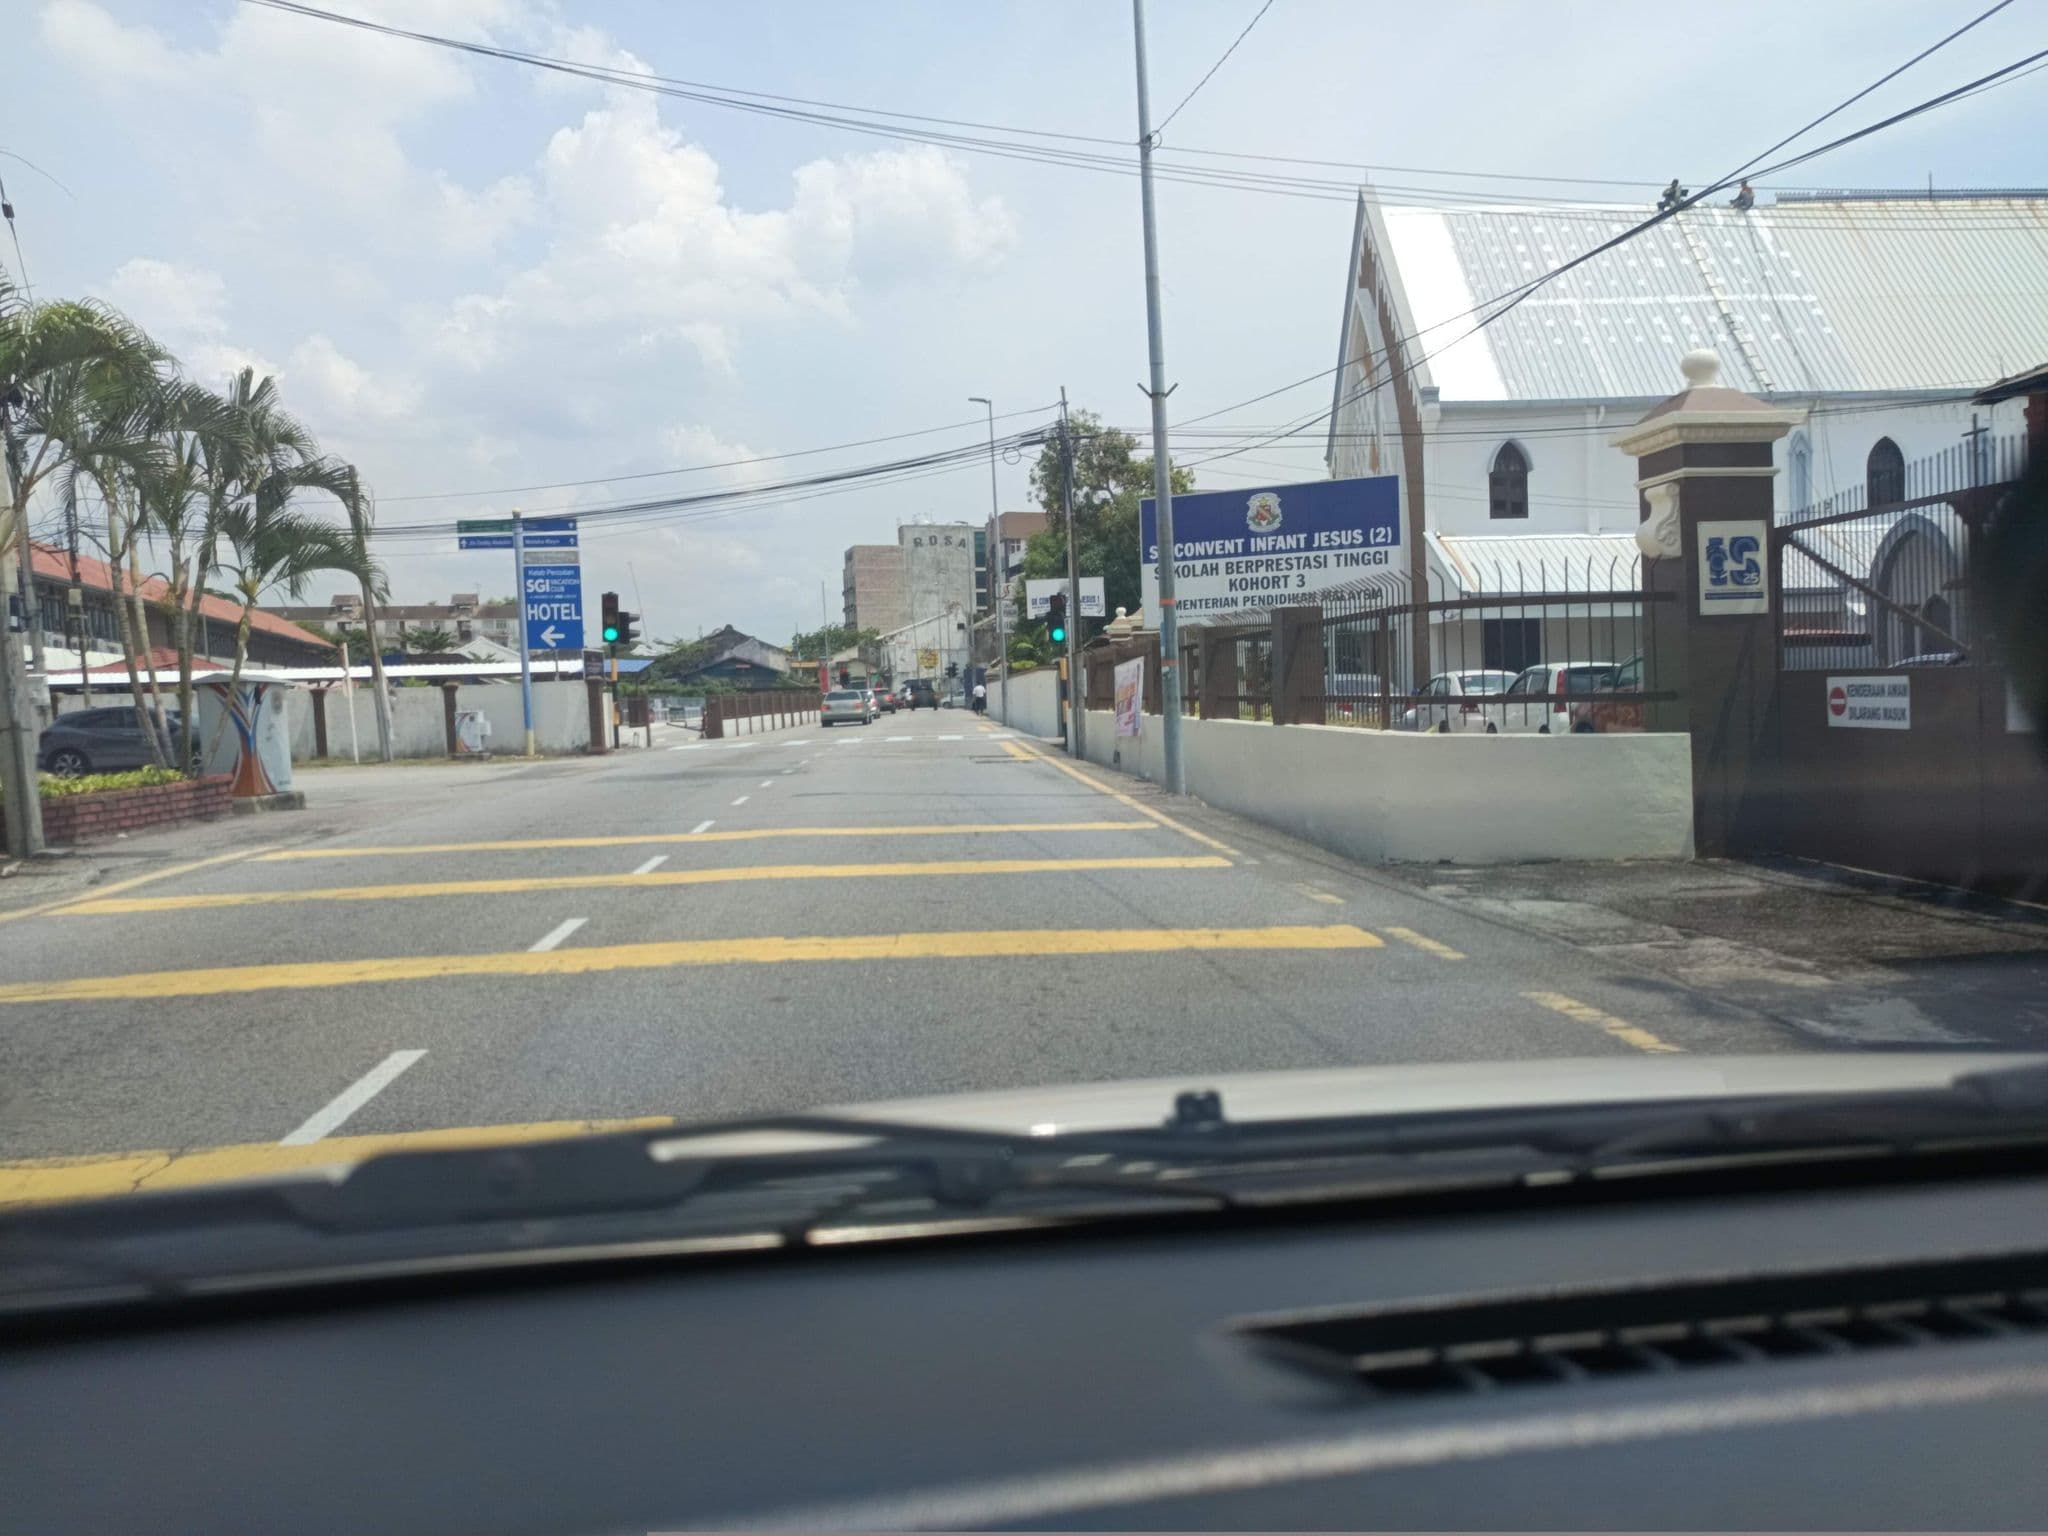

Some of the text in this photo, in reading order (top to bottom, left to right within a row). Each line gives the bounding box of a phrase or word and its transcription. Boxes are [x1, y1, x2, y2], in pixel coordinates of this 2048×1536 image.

[913, 535, 966, 548] ROSA
[1174, 538, 1245, 558] CONVENT
[1250, 532, 1307, 553] INFANT
[1312, 528, 1363, 547] JESUS
[1369, 526, 1392, 544] (2)
[1154, 550, 1388, 580] SKOLAH BERPRESTASI TINGGI
[526, 578, 550, 593] SGI
[1229, 573, 1306, 592] KOHORT 3
[527, 603, 581, 621] HOTEL
[1175, 596, 1239, 611] MENTERIAN
